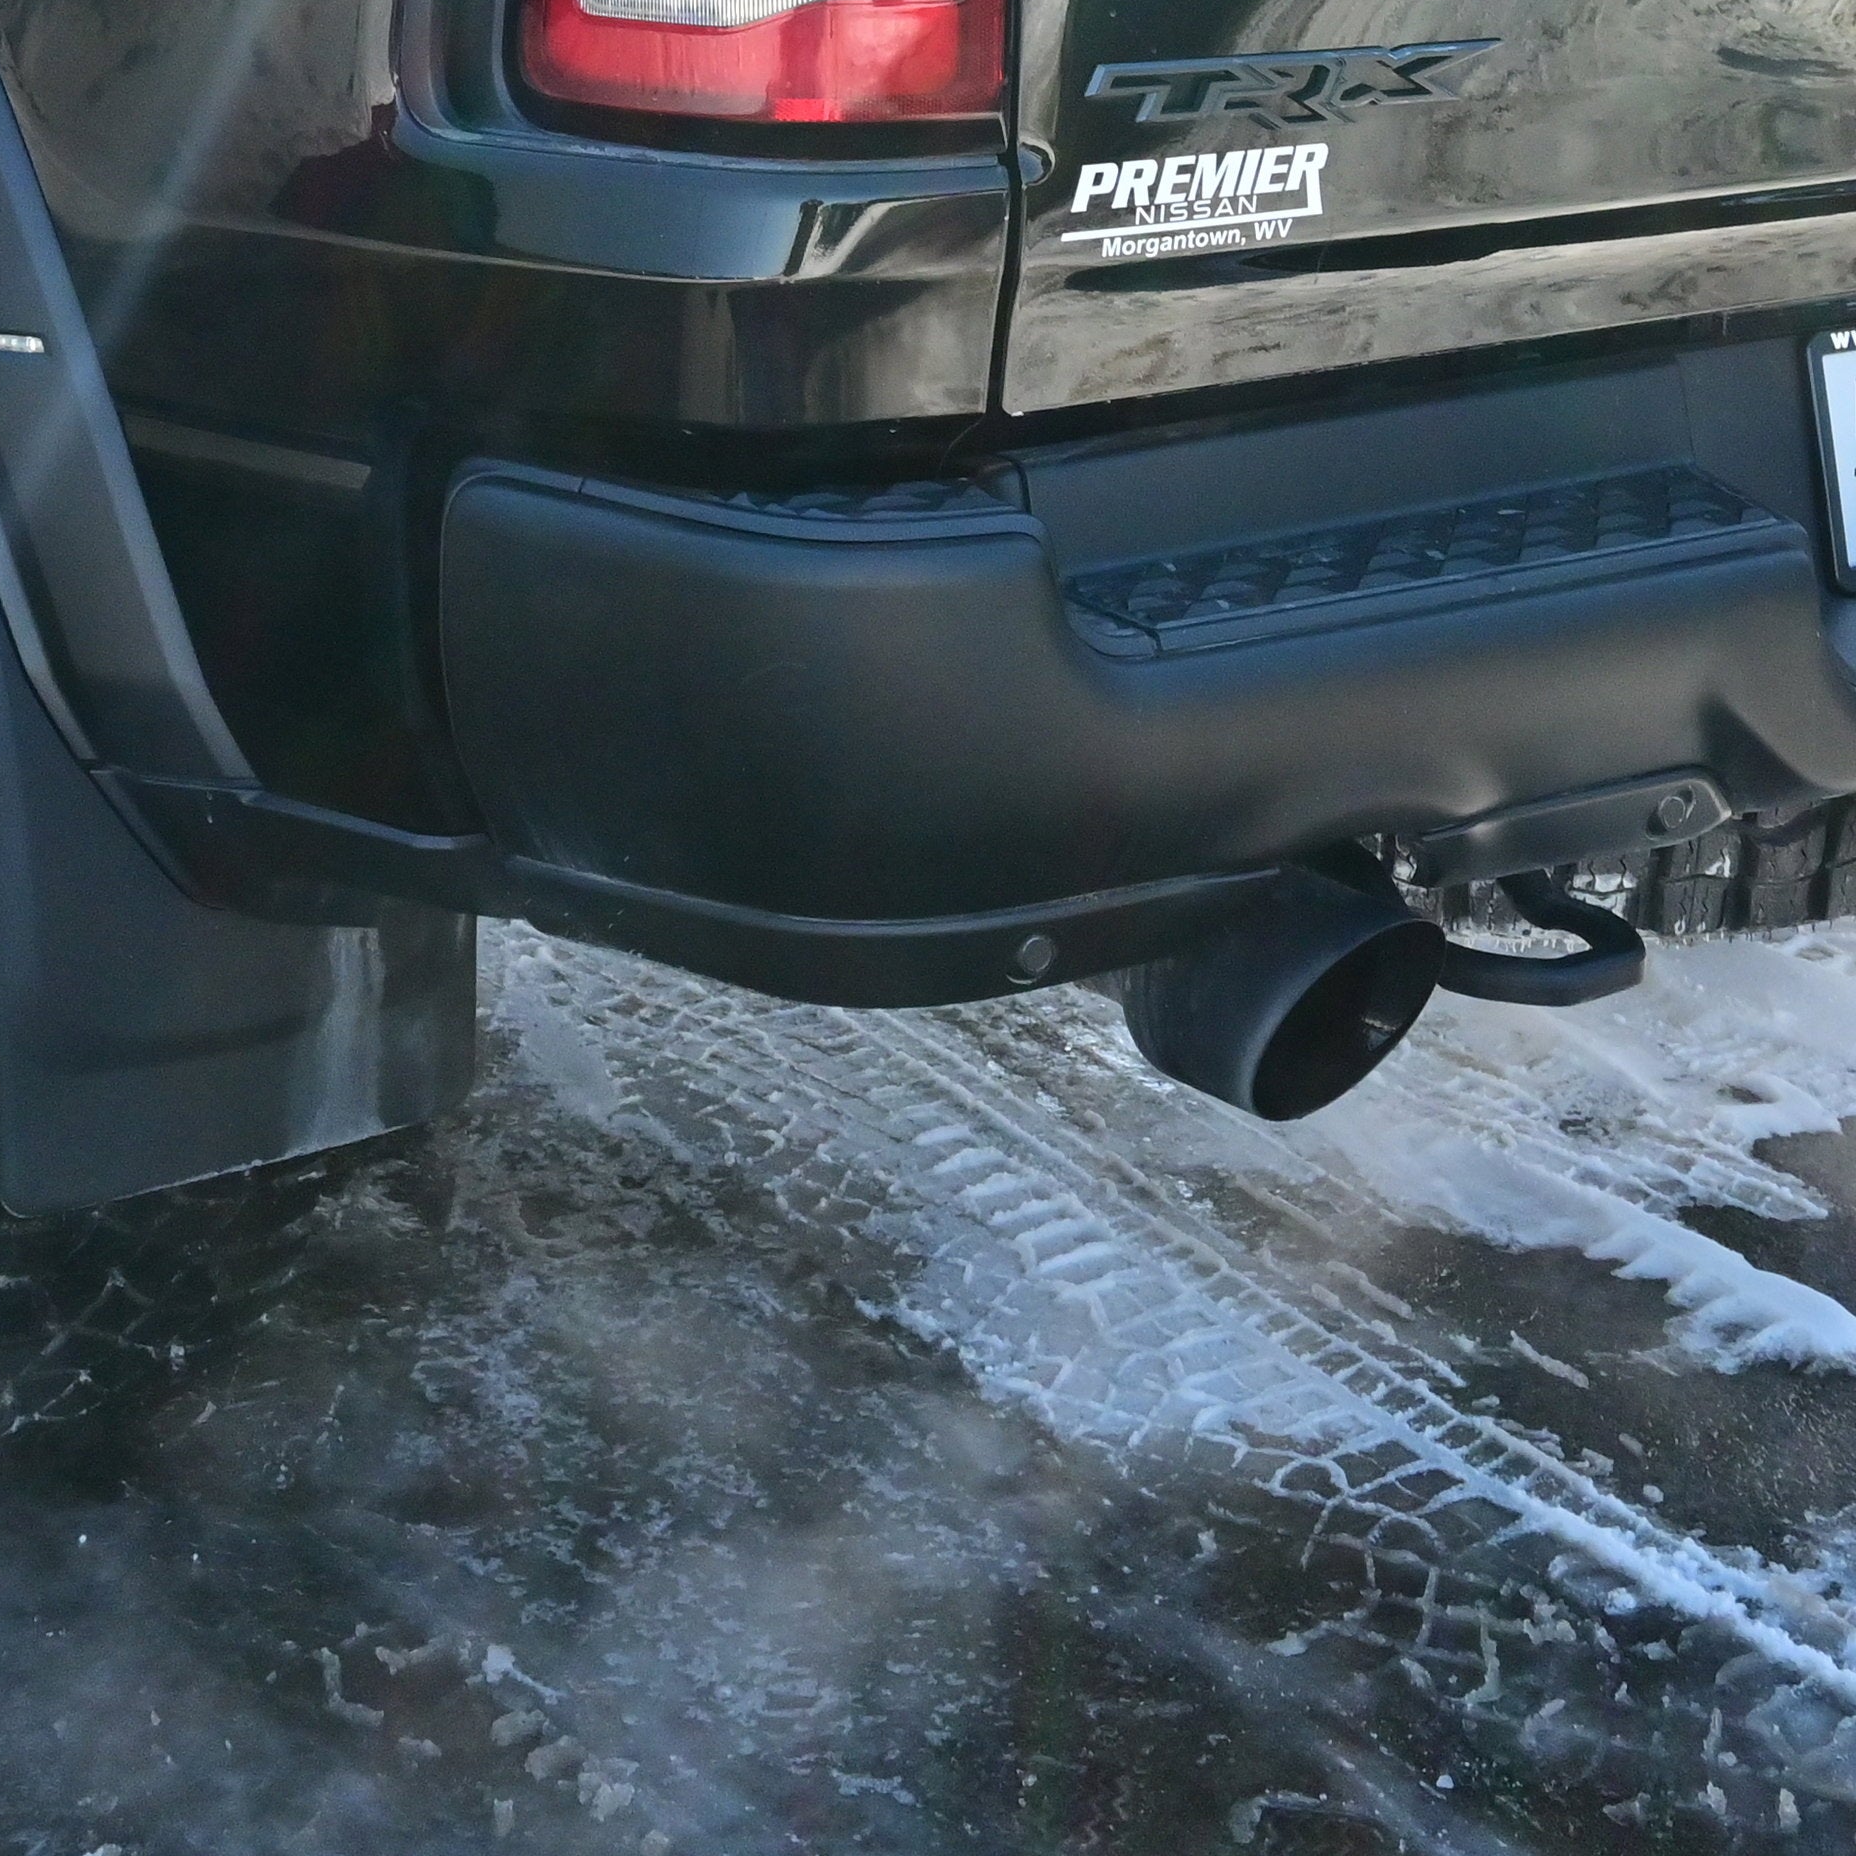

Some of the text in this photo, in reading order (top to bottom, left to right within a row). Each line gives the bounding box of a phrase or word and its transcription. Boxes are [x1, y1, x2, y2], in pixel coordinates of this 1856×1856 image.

[1083, 38, 1504, 131] TRX
[1070, 143, 1329, 213] PREMIER
[1135, 194, 1258, 226] NISSAN
[1101, 218, 1293, 257] Morgantown, WV
